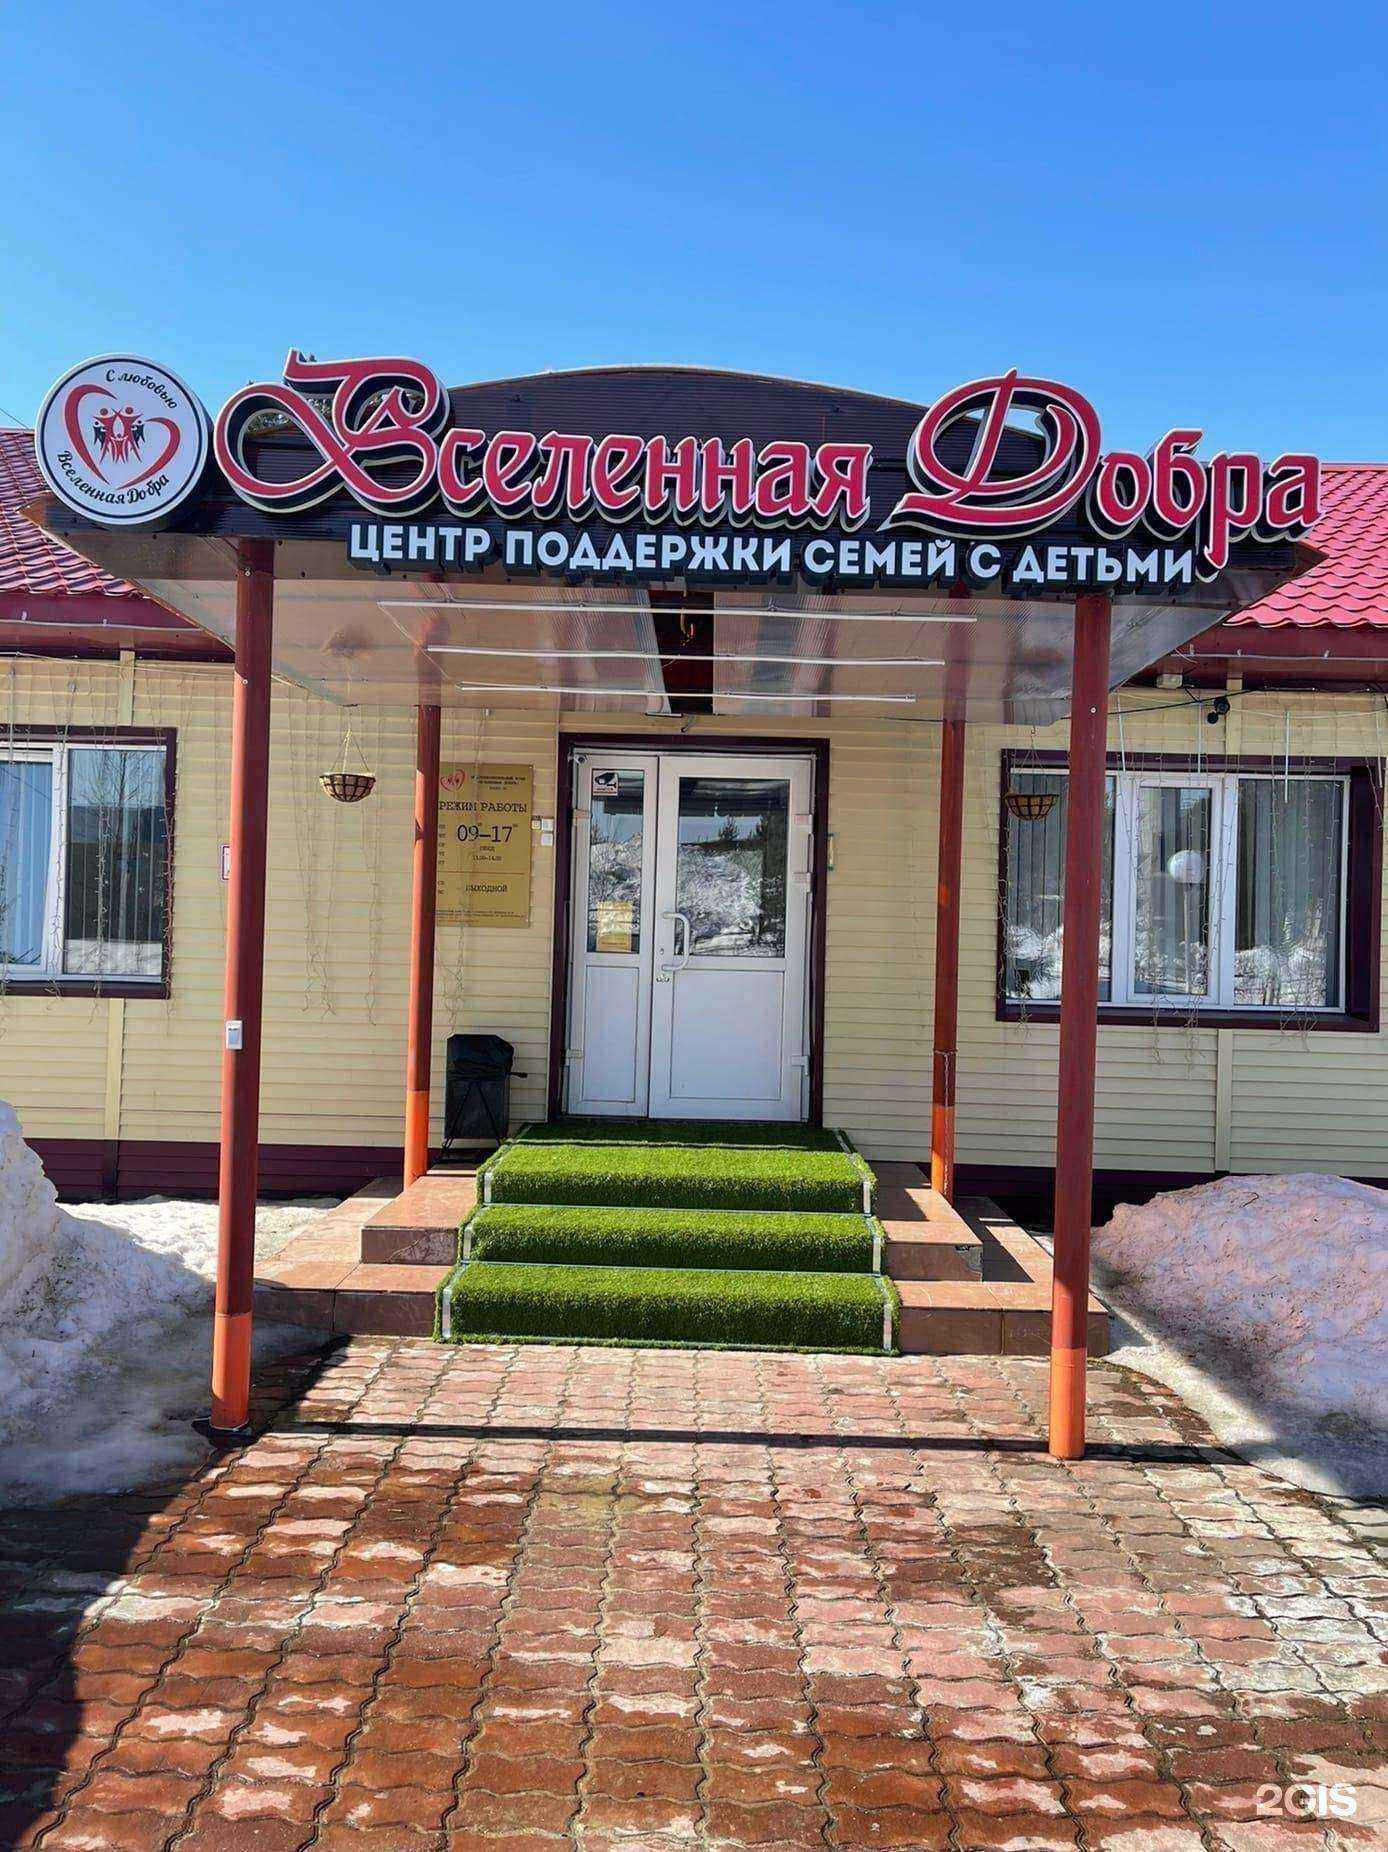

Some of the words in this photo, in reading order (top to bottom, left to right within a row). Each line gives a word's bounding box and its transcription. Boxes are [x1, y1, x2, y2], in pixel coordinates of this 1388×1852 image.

[105, 369, 116, 382] С
[118, 371, 178, 409] любовью
[57, 450, 125, 504] Вселенная
[127, 473, 170, 504] Добра
[213, 346, 874, 521] Вселенная
[876, 366, 1322, 570] Добра
[350, 524, 491, 562] ЦЕНТР
[506, 530, 791, 573] ПОДДЕРЖКИ
[804, 538, 955, 577] СЕМЕЙ
[969, 541, 1001, 578] С
[1012, 544, 1192, 583] ДЕТЬМИ
[439, 801, 477, 811] РЕЖИМ
[480, 802, 527, 813] РАБОТЫ
